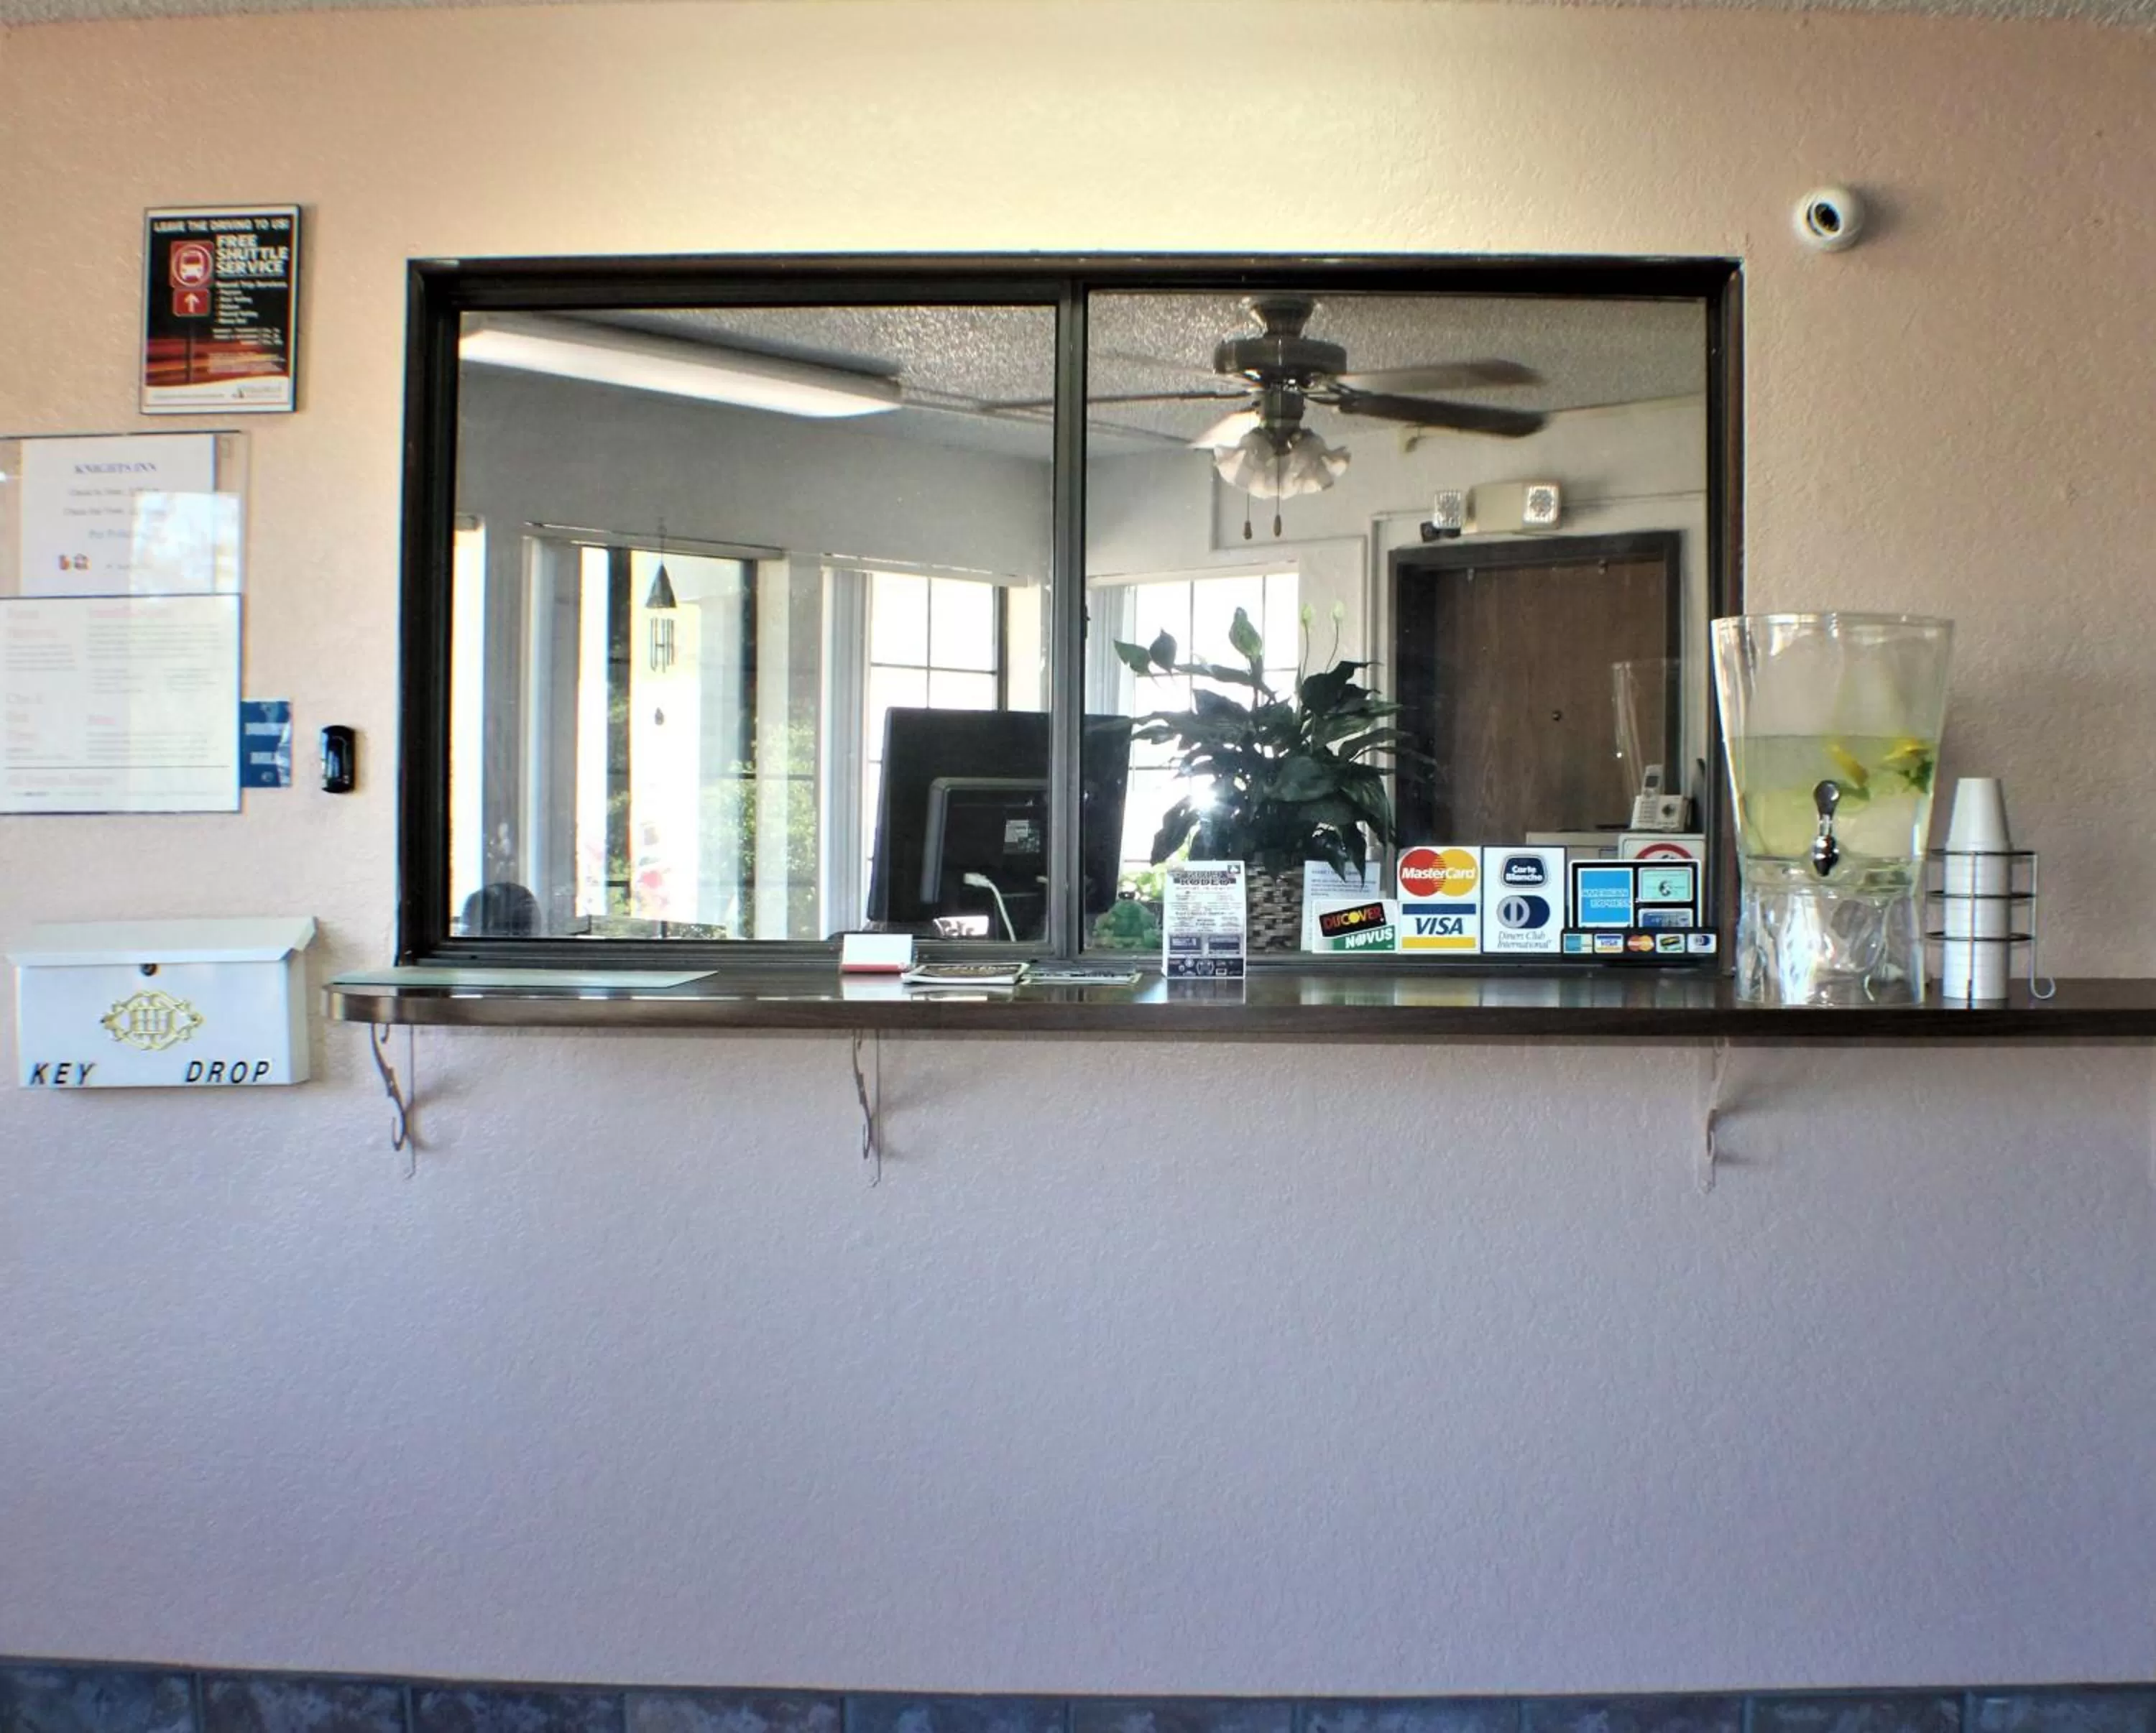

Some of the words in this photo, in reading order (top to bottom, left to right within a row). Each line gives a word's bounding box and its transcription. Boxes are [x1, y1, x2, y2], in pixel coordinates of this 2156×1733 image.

[254, 218, 270, 230] TO
[216, 234, 258, 248] FREE
[216, 246, 289, 262] SHUTTLE
[216, 259, 285, 276] SERVICE
[134, 462, 157, 472] INN
[1401, 867, 1475, 879] MasterCard
[1511, 865, 1537, 874] Carte
[1506, 873, 1543, 882] Blanche
[1415, 917, 1463, 935] VISA
[1345, 928, 1393, 949] NOVUS
[1526, 930, 1545, 940] Club
[30, 1062, 95, 1085] KEY
[185, 1060, 271, 1085] DROP
